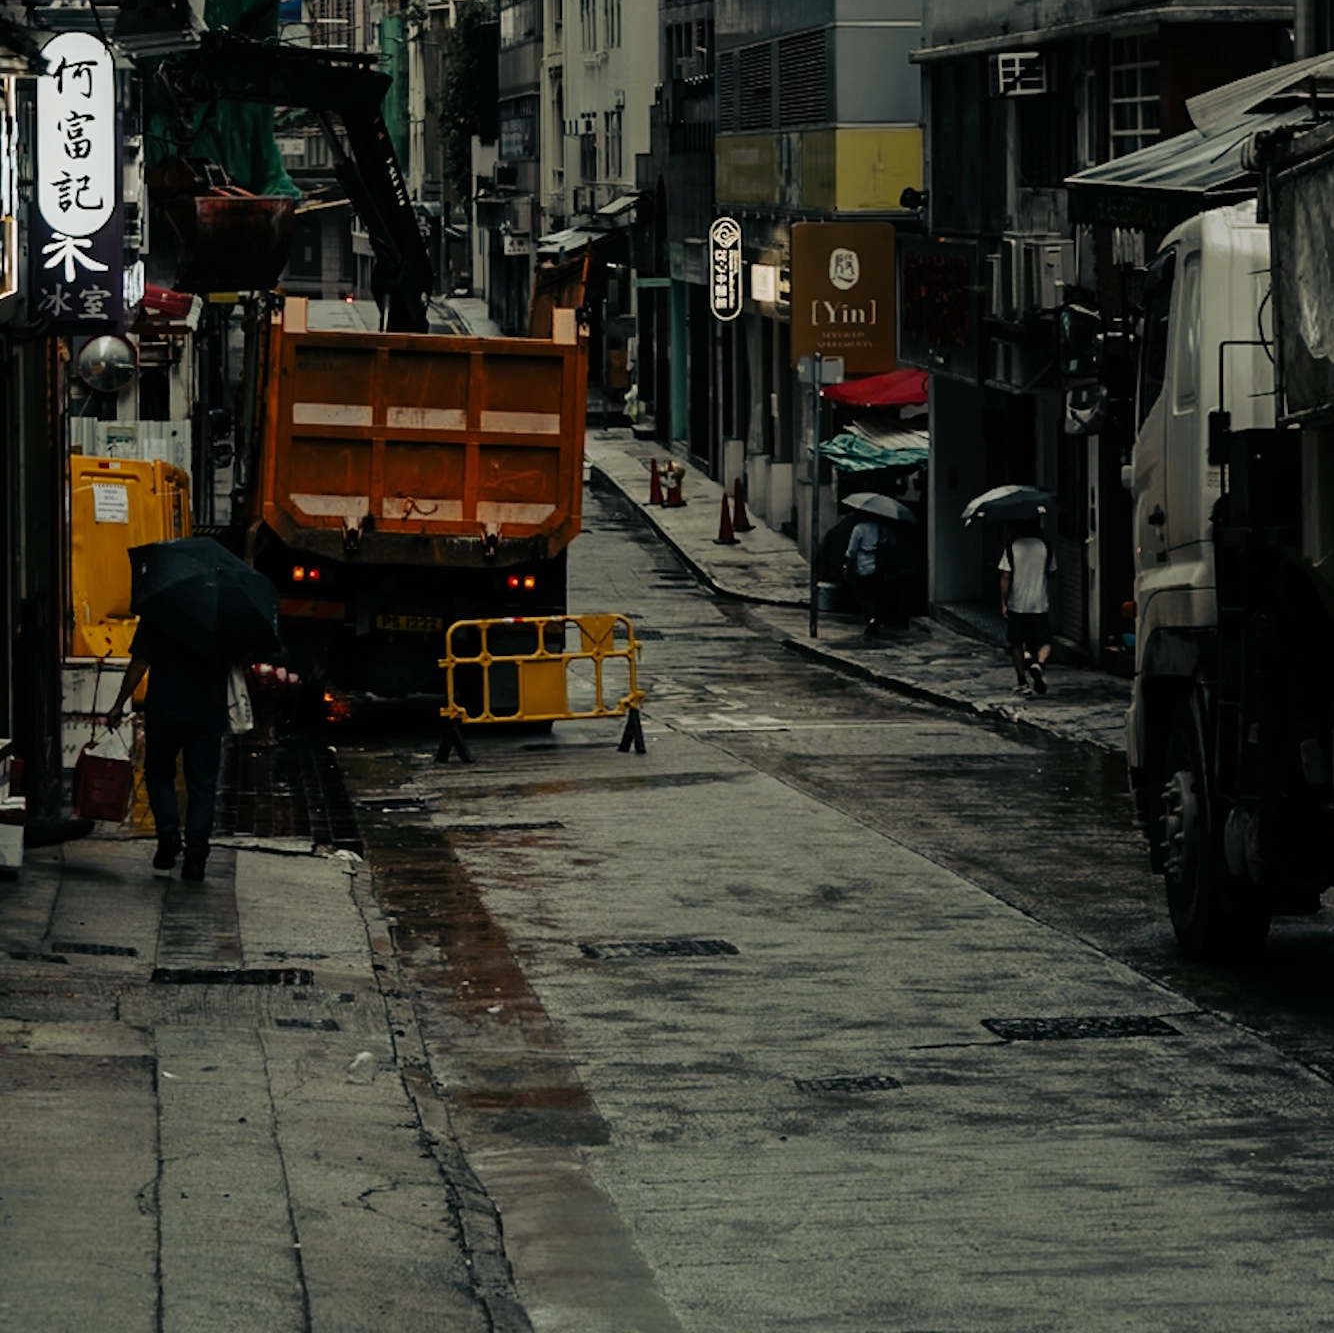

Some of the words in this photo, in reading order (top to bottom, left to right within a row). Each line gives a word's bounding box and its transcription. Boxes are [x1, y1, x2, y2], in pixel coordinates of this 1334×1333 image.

[51, 56, 104, 213] 何富記
[37, 283, 112, 321] 冰室
